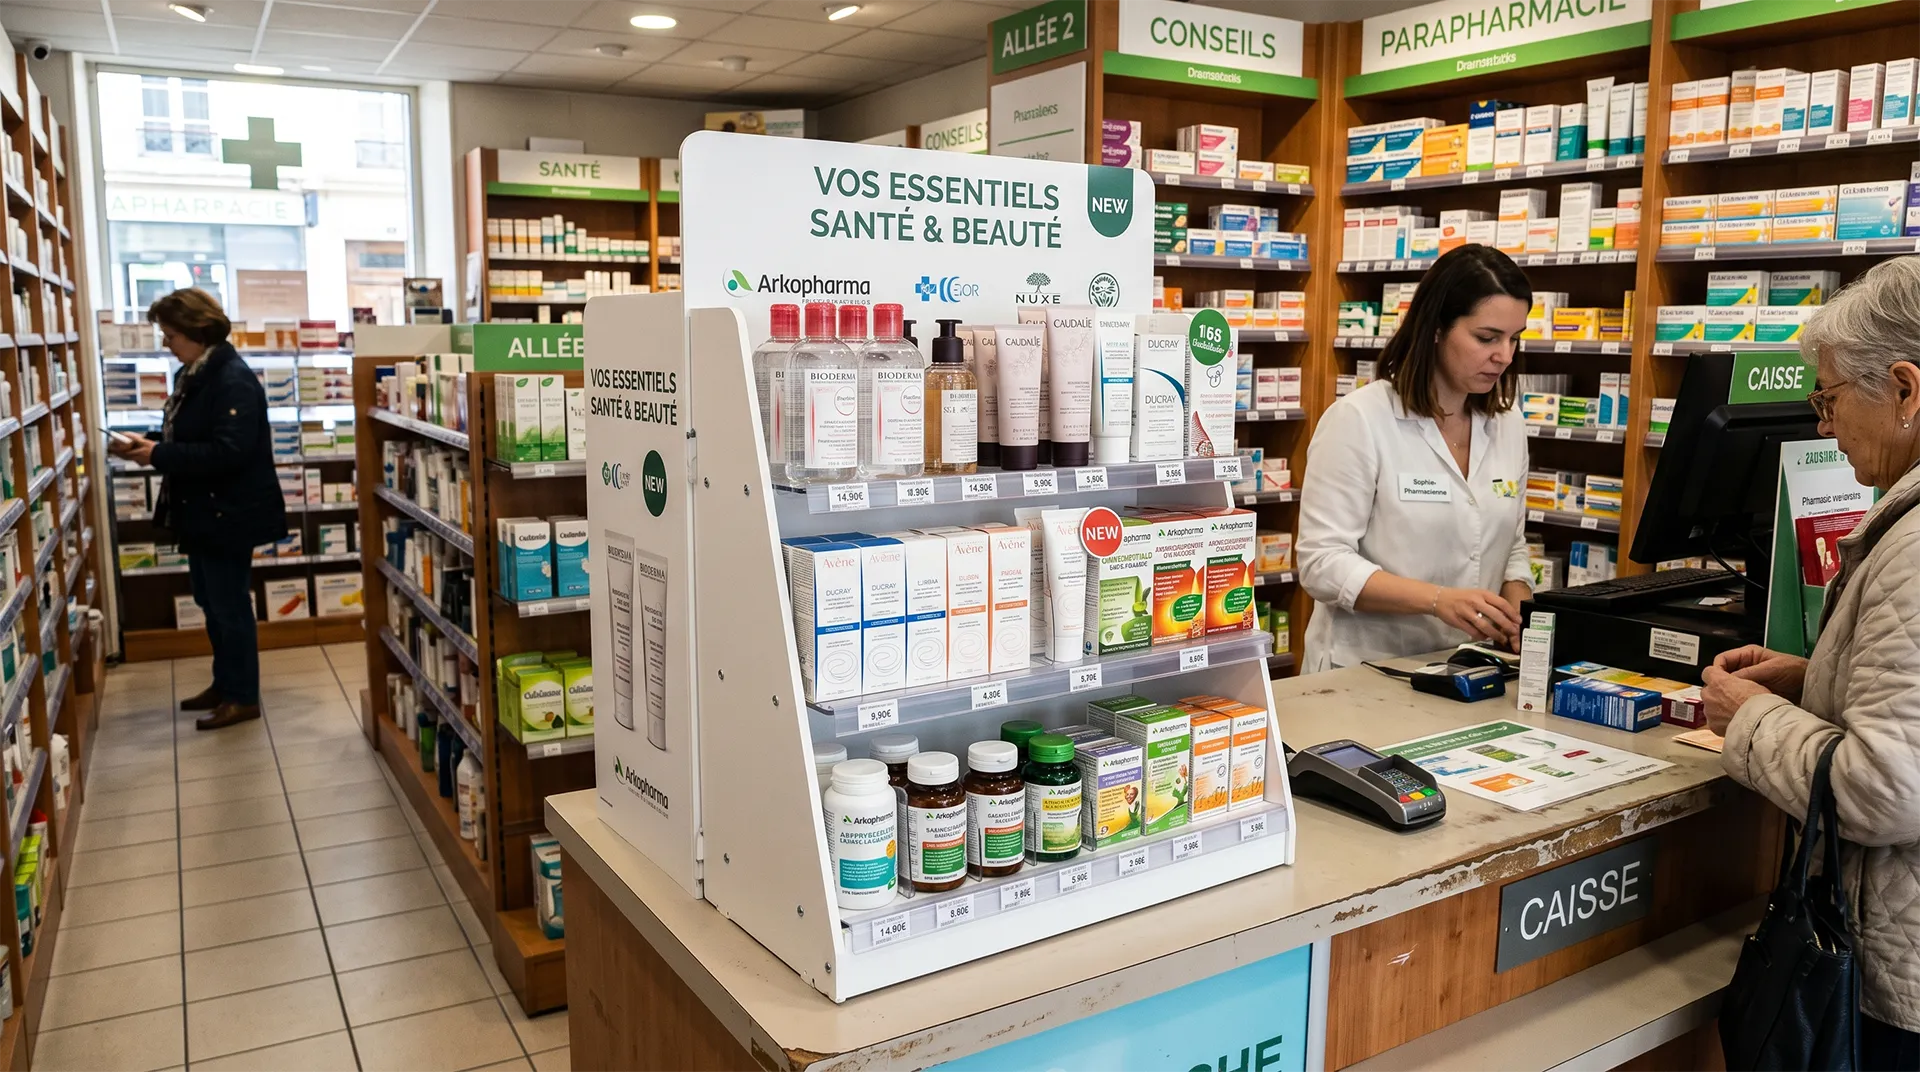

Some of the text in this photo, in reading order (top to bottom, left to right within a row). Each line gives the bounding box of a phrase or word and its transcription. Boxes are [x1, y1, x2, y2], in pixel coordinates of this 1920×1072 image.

[1002, 12, 1075, 58] ALLÉE 2
[1150, 16, 1276, 59] CONSEILS
[925, 122, 983, 150] CONSEILS
[539, 160, 601, 179] SANTÉ
[813, 166, 1060, 211] VOS ESSENTIELS
[1091, 197, 1129, 215] NEW
[810, 206, 1063, 249] SANTÉ & BEAUTÉ
[757, 273, 871, 298] Arkopharma
[1015, 294, 1061, 305] NUXE
[507, 332, 584, 358] ALLÉE
[1147, 339, 1180, 349] DUCRAY
[590, 368, 677, 394] VOS ESSENTIELS
[810, 372, 856, 381] BIODERMA
[877, 371, 922, 380] BIODERMA
[1747, 365, 1805, 391] CAISSE
[1145, 394, 1177, 405] DUCRAY
[590, 394, 678, 426] SANTÉ & BEAUTÉ
[644, 475, 665, 494] NEW
[1404, 487, 1447, 496] Pharmacienne
[836, 491, 864, 502] 14.90€
[1085, 525, 1119, 541] NEW
[954, 544, 984, 555] Avène
[997, 539, 1026, 550] Avène
[822, 556, 855, 569] Avène
[825, 587, 852, 597] DUCRAY
[871, 582, 897, 592] DUCRAY
[625, 765, 669, 810] Arkopharma
[1519, 860, 1641, 941] CAISSE
